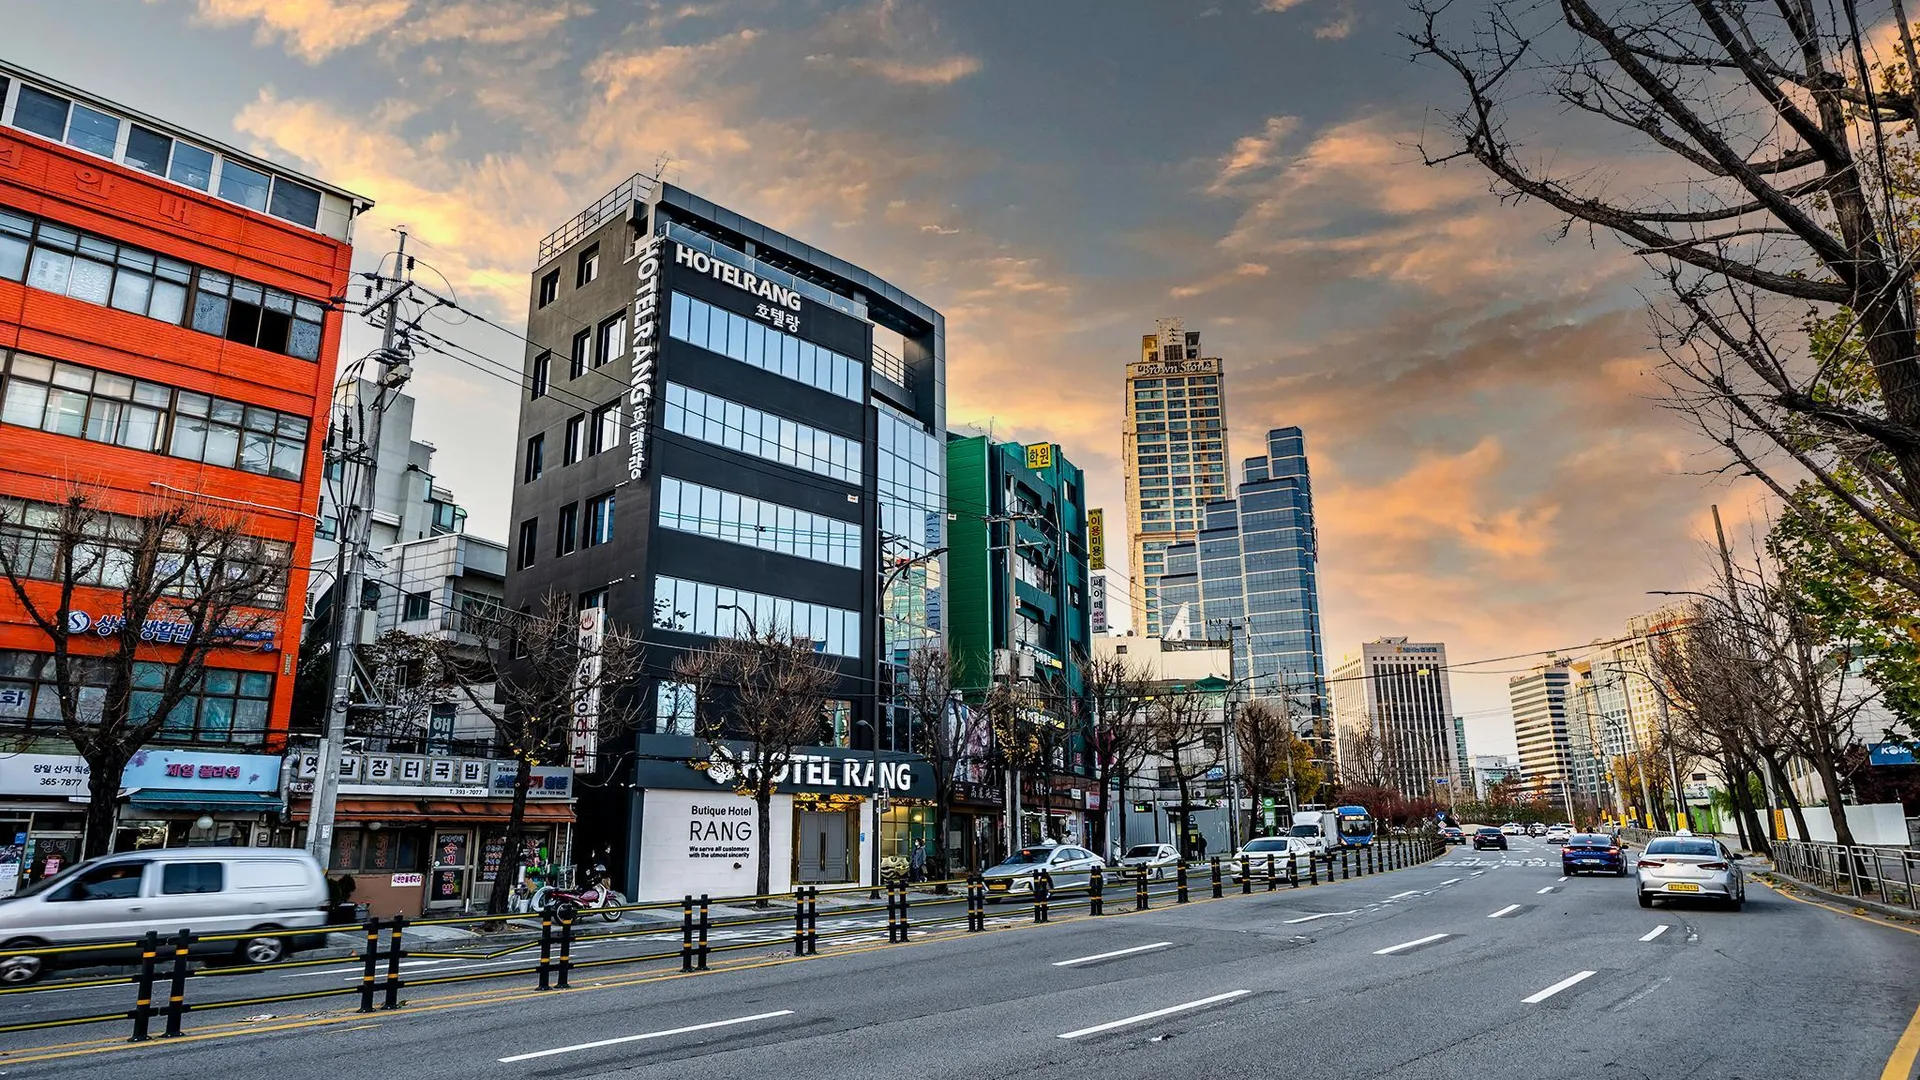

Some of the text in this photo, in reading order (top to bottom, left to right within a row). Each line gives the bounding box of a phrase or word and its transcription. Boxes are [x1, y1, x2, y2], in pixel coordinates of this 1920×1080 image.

[675, 243, 802, 312] HOTELRANG
[631, 236, 660, 405] HOTELRANG
[755, 303, 801, 333] 호텔랑
[1138, 360, 1212, 377] Brown Stone
[1029, 446, 1050, 467] 학원
[1091, 517, 1102, 557] 이용미용
[33, 765, 52, 774] 당일
[54, 765, 72, 774] 산지
[198, 765, 241, 780] 플라워
[843, 758, 912, 791] RANG
[691, 805, 752, 817] Butique Hotel
[690, 820, 752, 841] RANG
